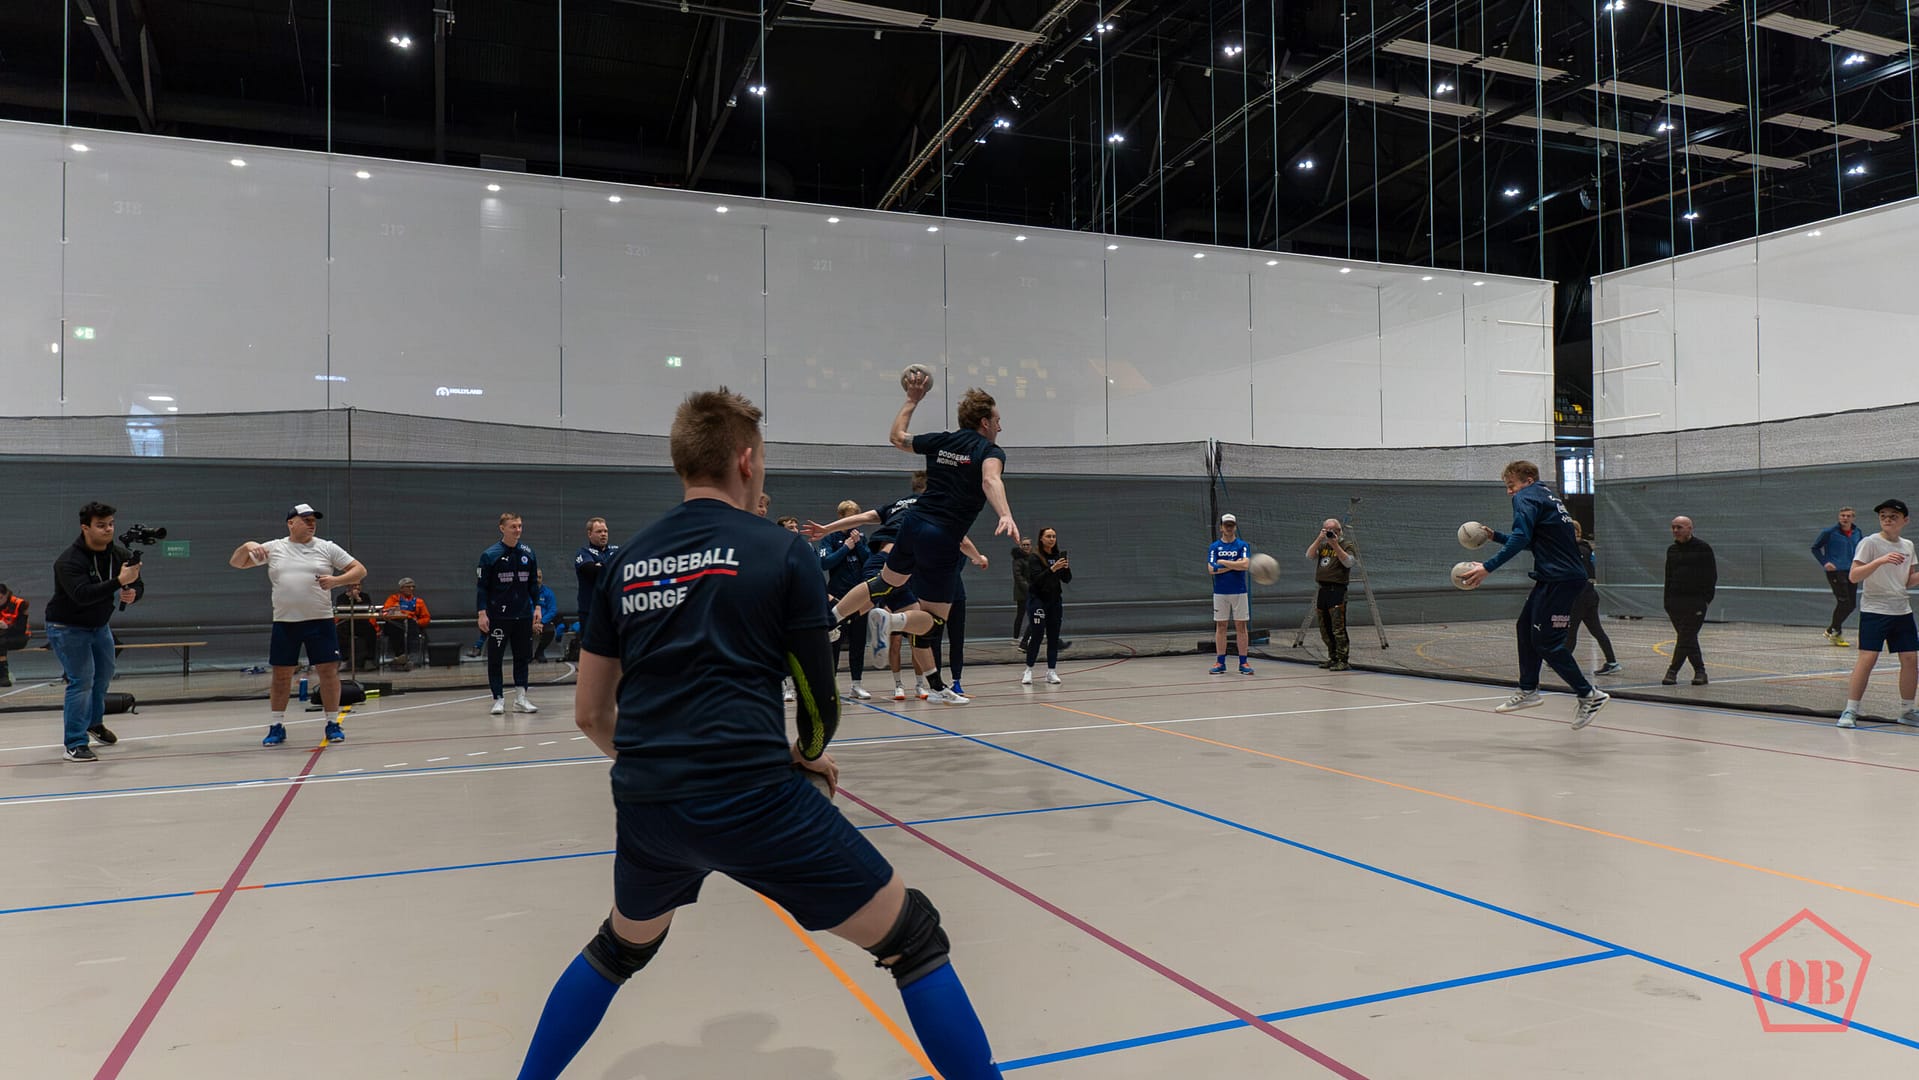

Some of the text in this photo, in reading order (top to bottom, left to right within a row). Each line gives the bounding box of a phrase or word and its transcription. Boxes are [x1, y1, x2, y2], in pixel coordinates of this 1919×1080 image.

[623, 547, 740, 582] DODGEBALL
[1218, 550, 1238, 558] coop
[621, 586, 689, 615] NORGE
